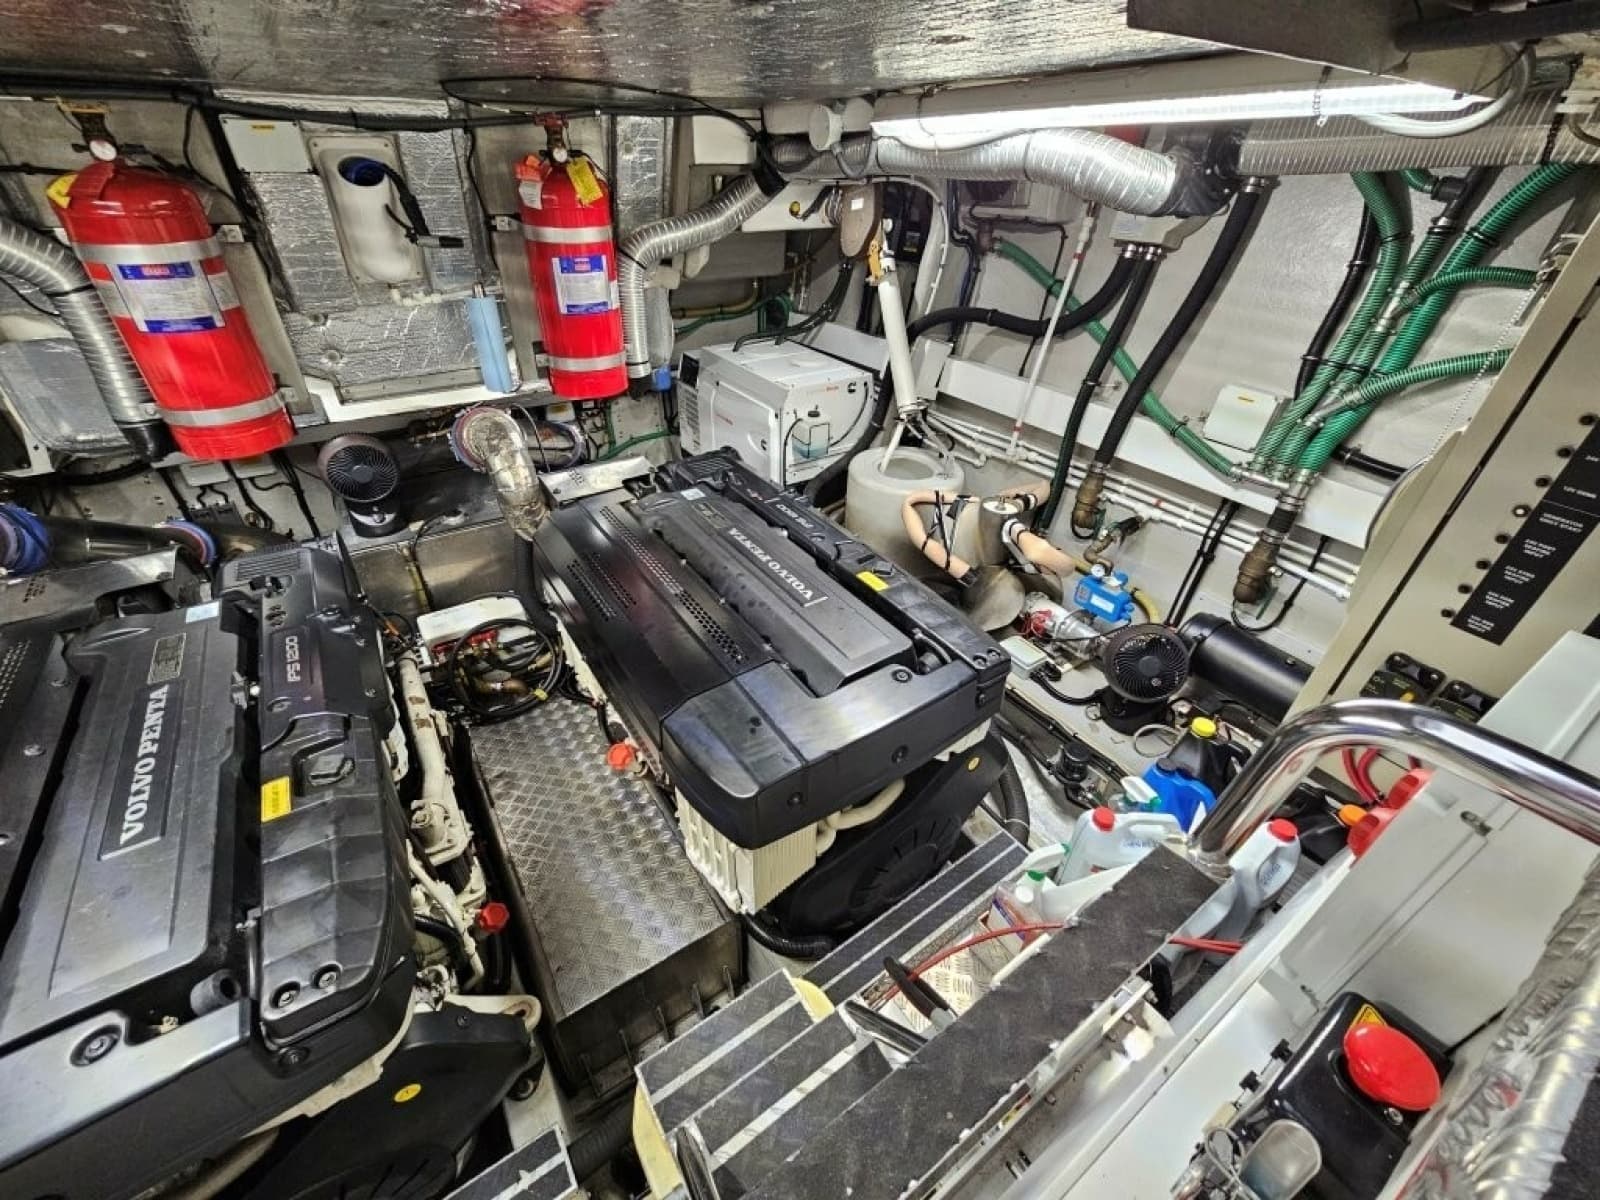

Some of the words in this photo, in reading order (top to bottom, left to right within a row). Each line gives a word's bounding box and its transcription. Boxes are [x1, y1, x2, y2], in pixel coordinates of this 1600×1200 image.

[728, 527, 772, 562] PENTA
[768, 560, 814, 601] VOLVO
[285, 635, 300, 662] 1200
[137, 684, 169, 758] PENTA
[119, 757, 156, 845] VOLVO
